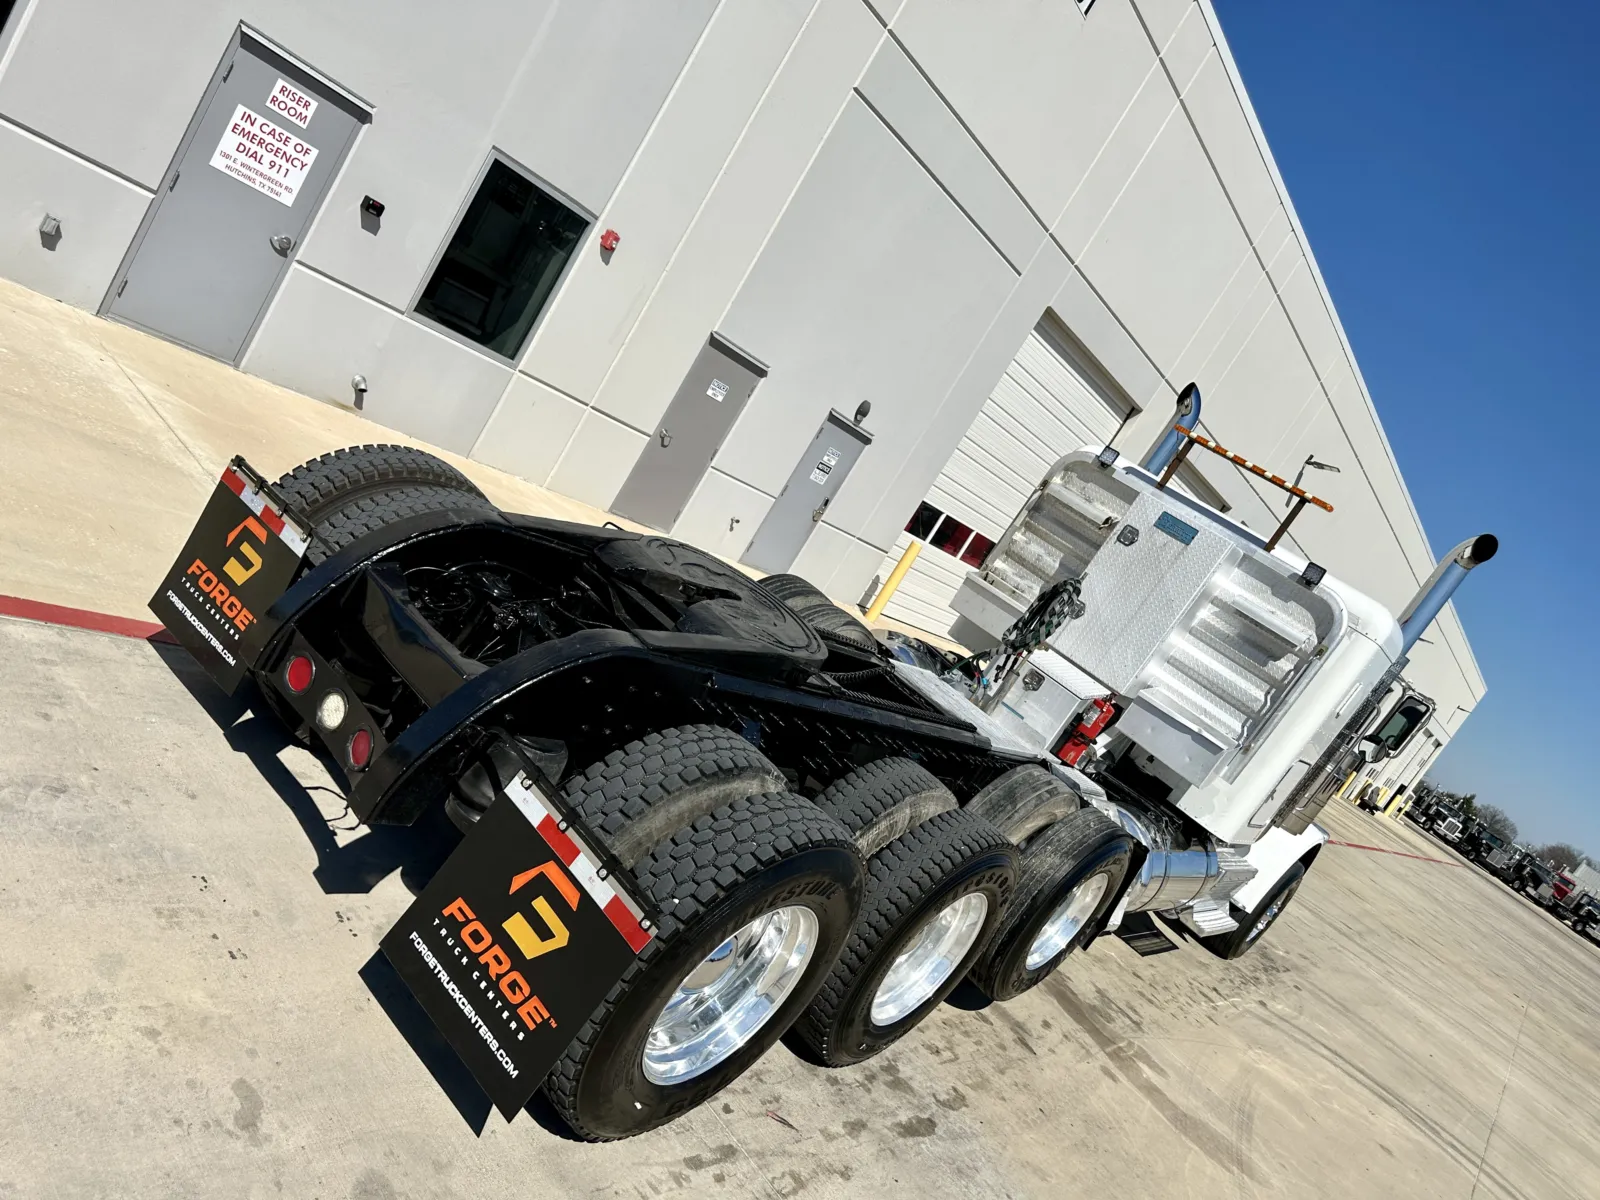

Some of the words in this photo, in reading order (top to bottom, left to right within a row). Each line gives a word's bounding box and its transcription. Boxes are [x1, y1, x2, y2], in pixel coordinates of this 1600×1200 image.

[269, 95, 308, 125] ROOM
[279, 85, 311, 111] RISER
[231, 122, 308, 171] EMERGENCY
[240, 111, 257, 127] IN
[259, 122, 292, 147] CASE
[293, 142, 312, 157] OF
[219, 150, 233, 161] 1301
[232, 157, 239, 165] E.
[239, 161, 284, 189] WINTERGREEN
[284, 185, 294, 195] RD.
[225, 164, 257, 185] HUTCHINS,
[258, 181, 266, 190] TX
[267, 187, 282, 198] 75141
[235, 142, 264, 165] DIAL
[268, 160, 290, 178] 911
[166, 589, 237, 667] FORGETRUCKCENTERS.COM
[181, 576, 204, 603] TRUCK
[205, 603, 240, 641] CENTERS
[433, 918, 469, 966] TRUCK
[472, 971, 525, 1041] CENTERS
[409, 931, 519, 1079] FORGETRUCKCENTERS.COM
